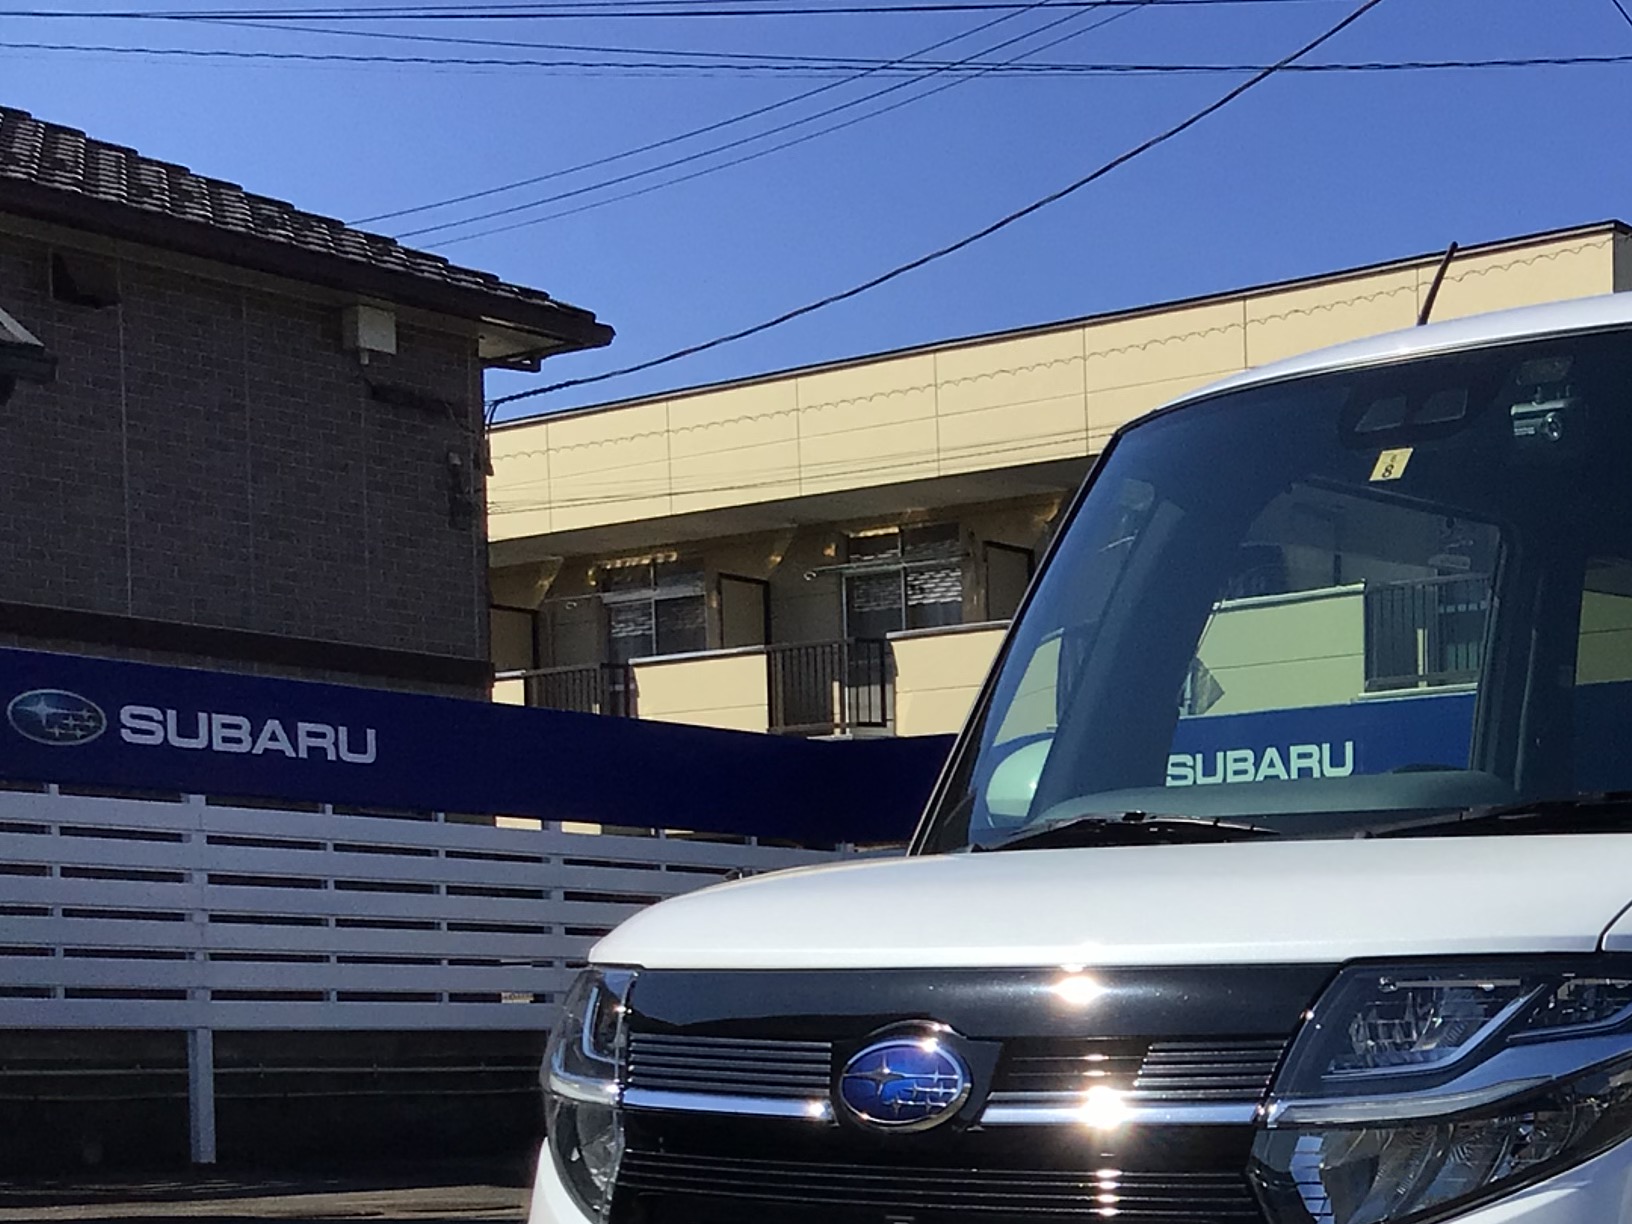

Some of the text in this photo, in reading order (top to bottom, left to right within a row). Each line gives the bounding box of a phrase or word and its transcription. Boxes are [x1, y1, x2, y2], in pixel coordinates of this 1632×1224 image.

[1381, 464, 1395, 478] 8
[120, 704, 377, 765] SUBARU
[1164, 740, 1354, 788] SUBARU
